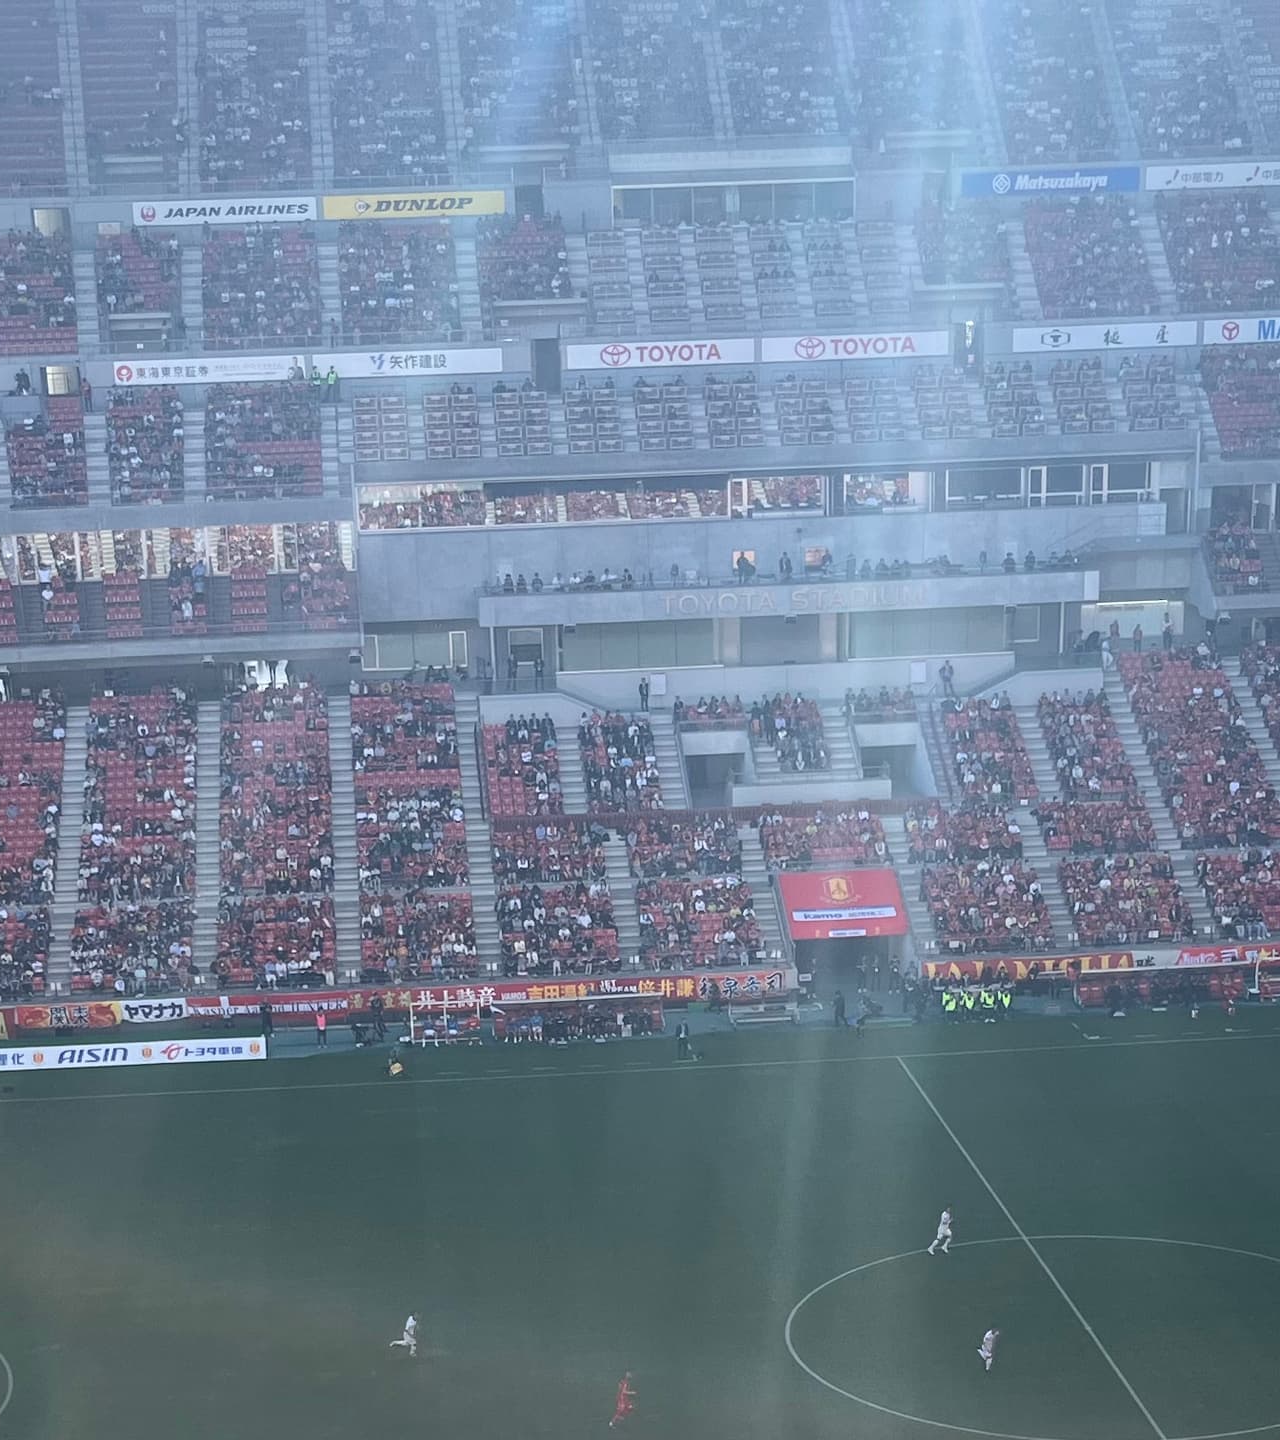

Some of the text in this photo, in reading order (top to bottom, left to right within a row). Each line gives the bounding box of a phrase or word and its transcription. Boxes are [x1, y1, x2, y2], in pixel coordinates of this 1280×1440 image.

[1015, 172, 1109, 193] Matsuzakaya
[1179, 171, 1224, 185] 中部電力
[163, 203, 309, 219] JAPAN AIRLINES
[374, 197, 473, 213] DUNLOP
[635, 343, 721, 363] TOYOTA
[830, 336, 916, 356] TOYOTA
[389, 353, 447, 370] 矢作建設
[136, 365, 209, 379] 東海東京証券
[664, 592, 776, 616] TOYOTA
[124, 1003, 184, 1019] ヤマナカ
[57, 1046, 129, 1064] AISIN
